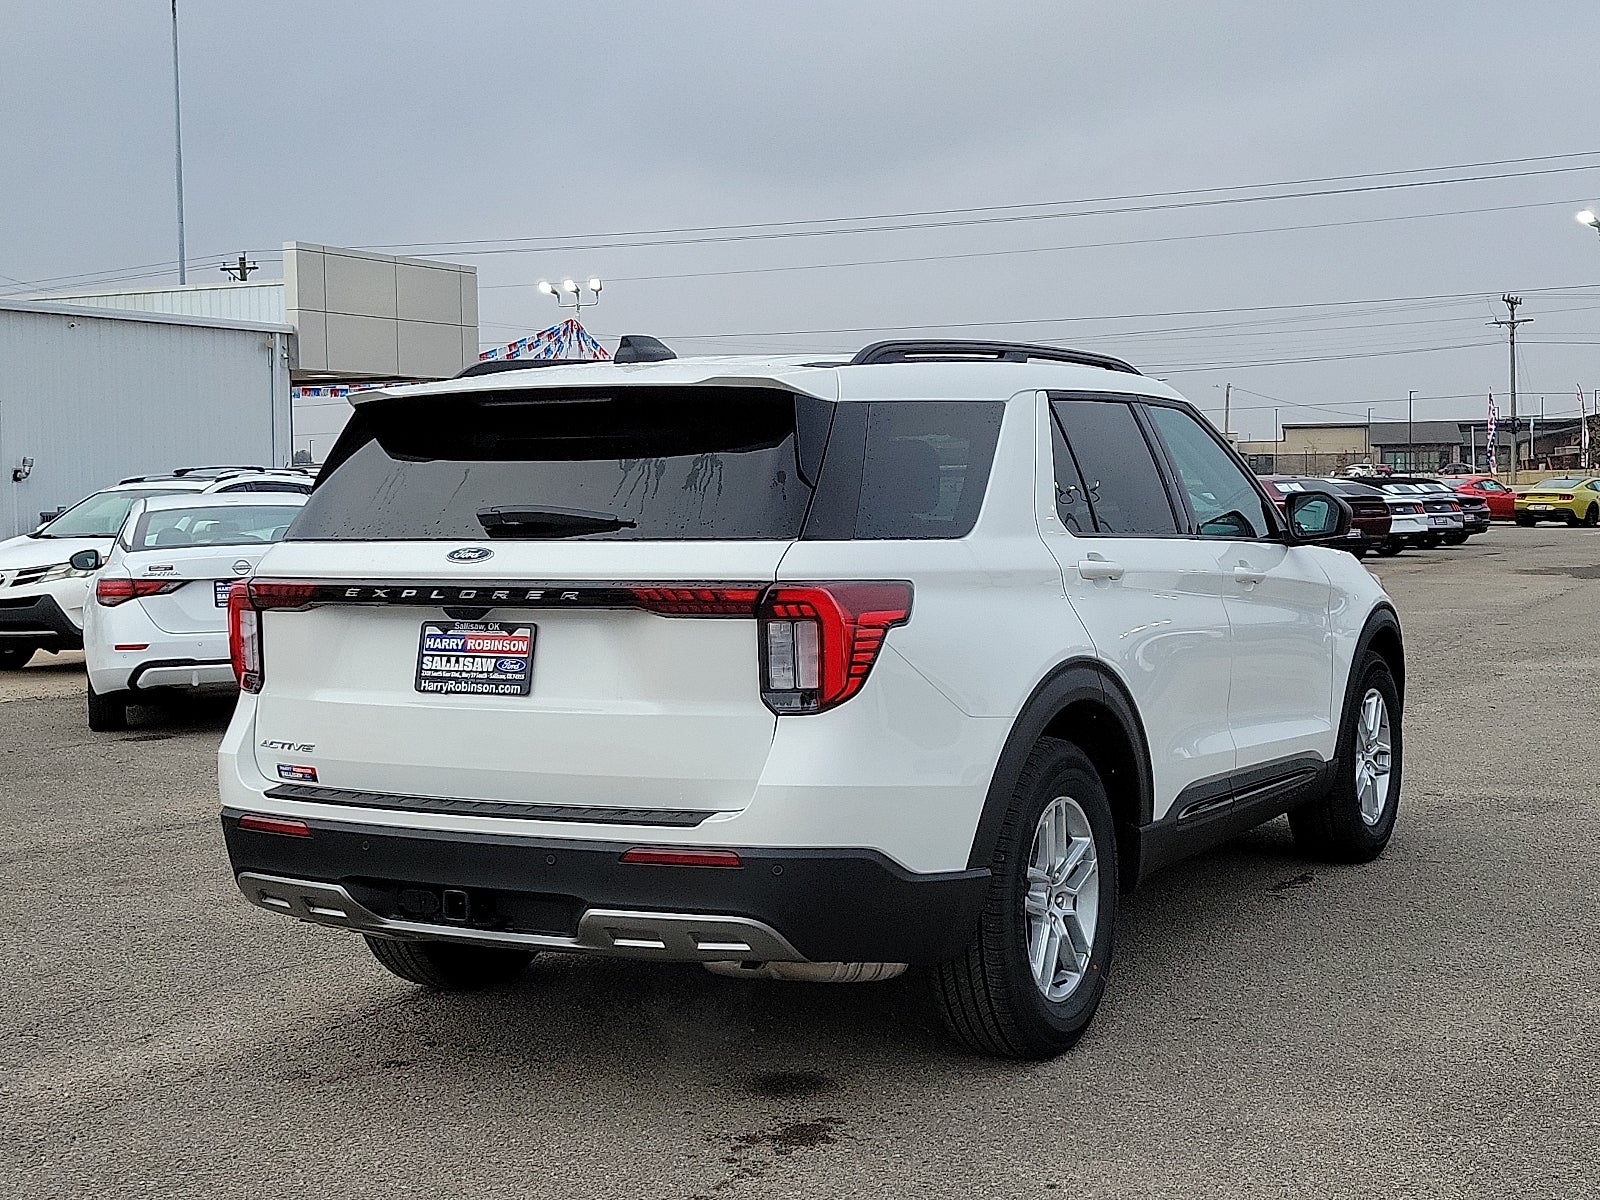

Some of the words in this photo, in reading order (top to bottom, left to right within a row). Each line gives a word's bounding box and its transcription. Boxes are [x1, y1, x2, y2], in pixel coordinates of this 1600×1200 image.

[453, 549, 484, 559] Ford
[345, 588, 580, 600] EXPLORER
[454, 622, 487, 632] Sallisaw,
[488, 622, 500, 630] OK
[425, 637, 466, 650] HARRY
[466, 639, 528, 652] ROBINSON
[422, 656, 497, 672] SALLISAW
[421, 680, 521, 694] HarryRobinson.com
[260, 739, 316, 753] ACTIVE
